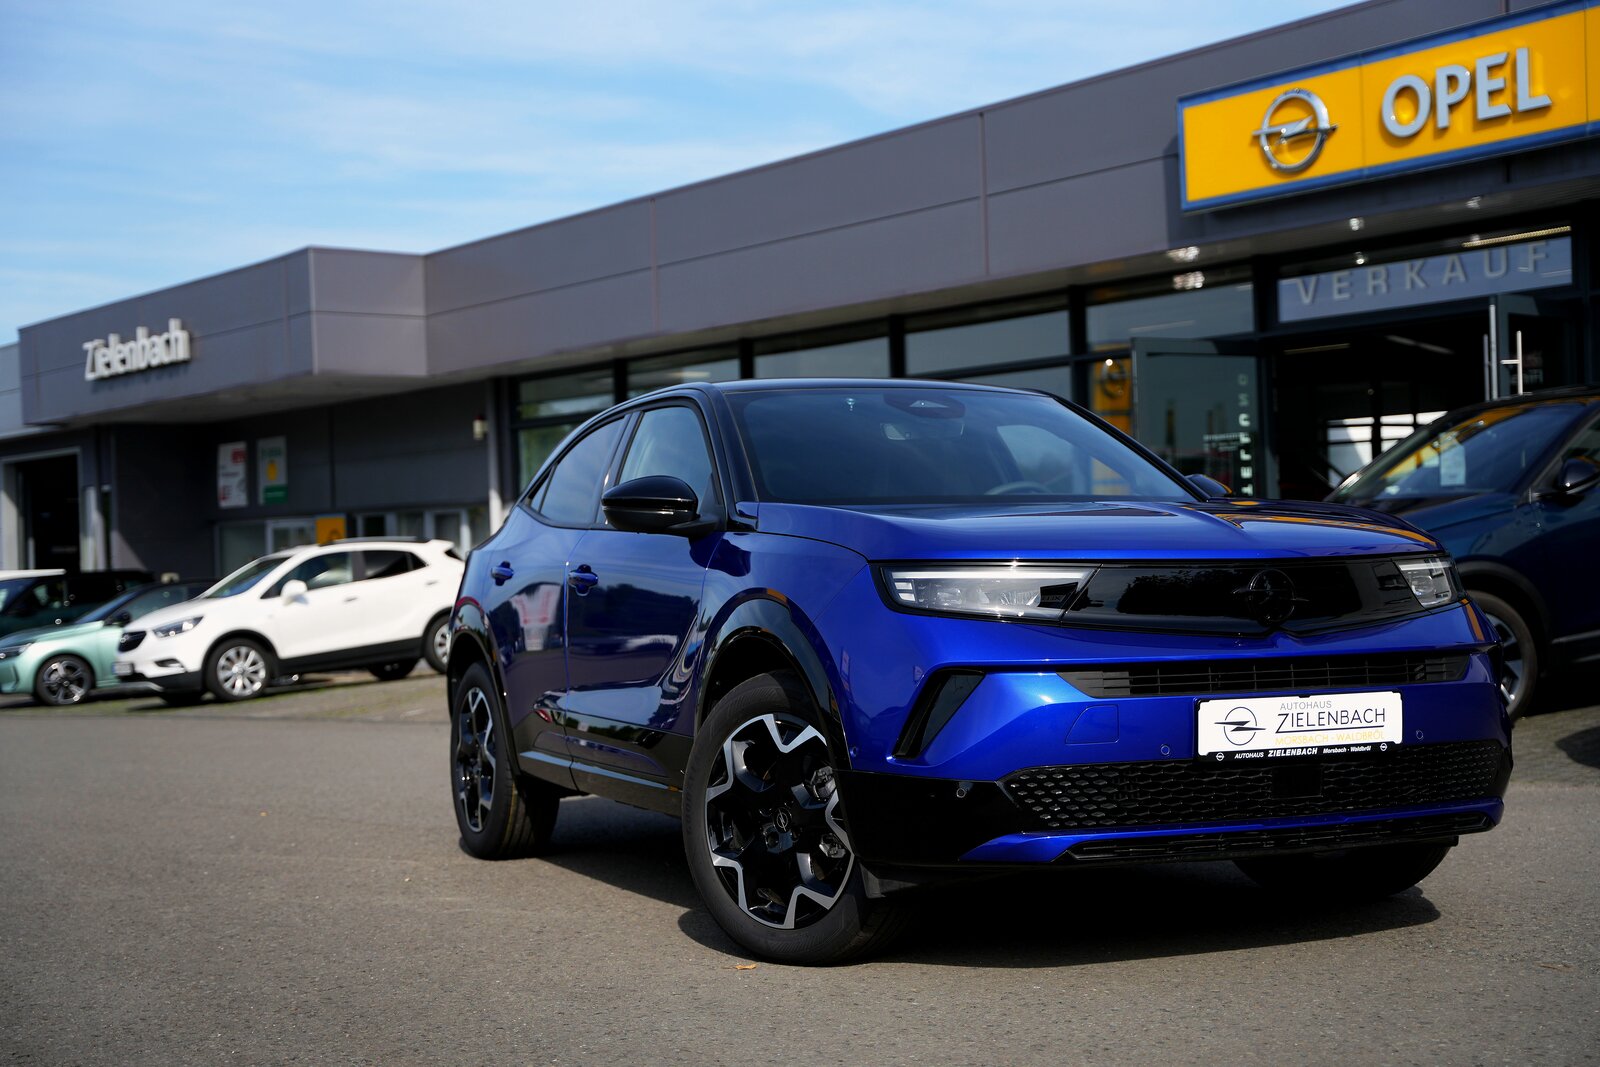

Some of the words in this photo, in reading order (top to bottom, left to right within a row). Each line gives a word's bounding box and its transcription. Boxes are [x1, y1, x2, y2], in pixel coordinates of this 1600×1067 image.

[1382, 47, 1552, 137] OPEL
[1296, 241, 1549, 305] VERKAUF
[83, 318, 191, 380] Zielenbach
[1280, 700, 1332, 711] AUTOHAUS
[1275, 708, 1386, 734] ZIELENBACH
[1275, 733, 1329, 746] MORSBACH
[1336, 729, 1384, 742] WALDBRÖL
[1234, 751, 1264, 759] AUTOHAUS
[1268, 747, 1318, 757] ZIELENBACH
